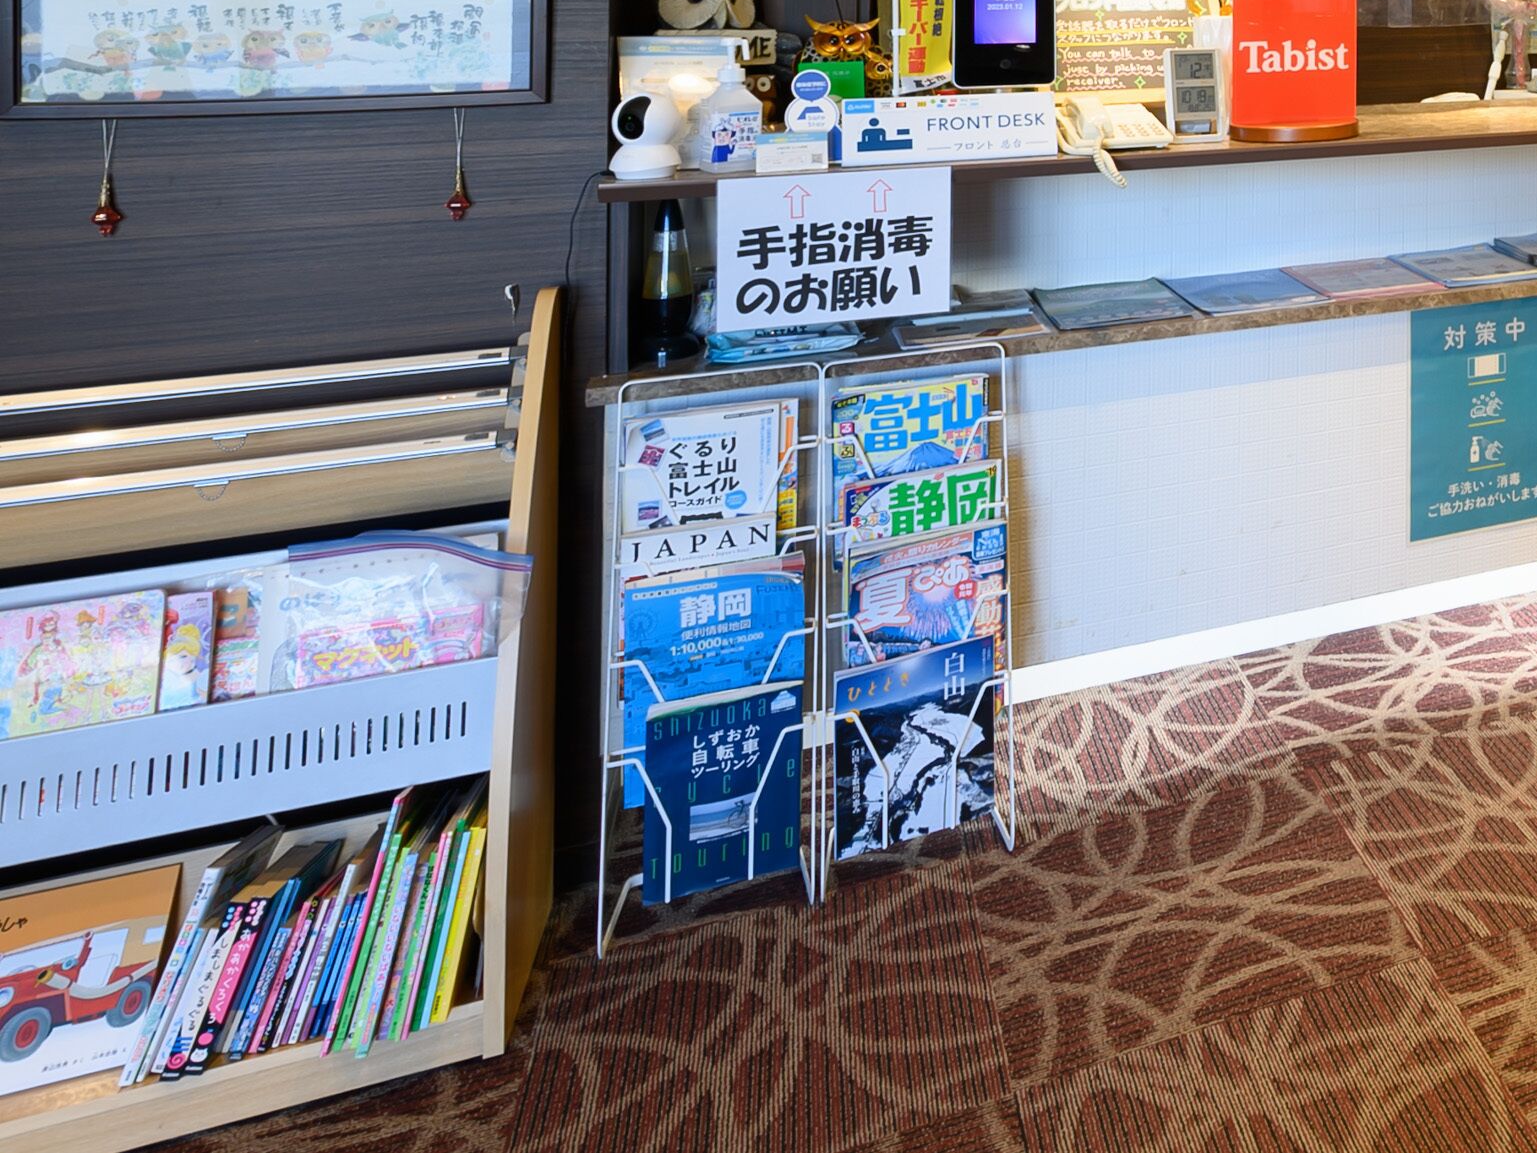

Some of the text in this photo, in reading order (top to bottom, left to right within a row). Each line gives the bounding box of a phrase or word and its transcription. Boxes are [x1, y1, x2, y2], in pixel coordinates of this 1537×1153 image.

[1059, 47, 1155, 60] You can talk to
[1238, 39, 1349, 74] Tabist
[1064, 64, 1089, 76] just
[1095, 63, 1108, 75] by
[1115, 63, 1154, 75] picking
[1066, 76, 1124, 87] receiver.
[926, 112, 1046, 132] FRONT DESK
[954, 141, 994, 152] フロント
[736, 215, 934, 270] 手指消毒
[736, 264, 922, 316] のお願い
[1443, 317, 1527, 351] 対策中
[863, 384, 984, 454] 富士山
[669, 436, 737, 460] ぐるり
[668, 457, 737, 480] 富士山
[669, 476, 740, 499] トレイル
[1448, 472, 1521, 497] 手洗い・消毒
[669, 495, 723, 509] コースガイド
[888, 469, 998, 537] 静岡
[851, 511, 891, 529] まっぷる
[631, 523, 771, 563] JAPAN
[680, 587, 752, 628] 静岡
[681, 619, 752, 641] 便利情報地図
[847, 673, 910, 702] ひととき
[944, 652, 965, 700] 白山
[693, 724, 761, 749] しずおか
[692, 738, 760, 766] 自転車
[691, 752, 761, 779] ツーリング
[188, 937, 229, 1032] しましまぐるぐる
